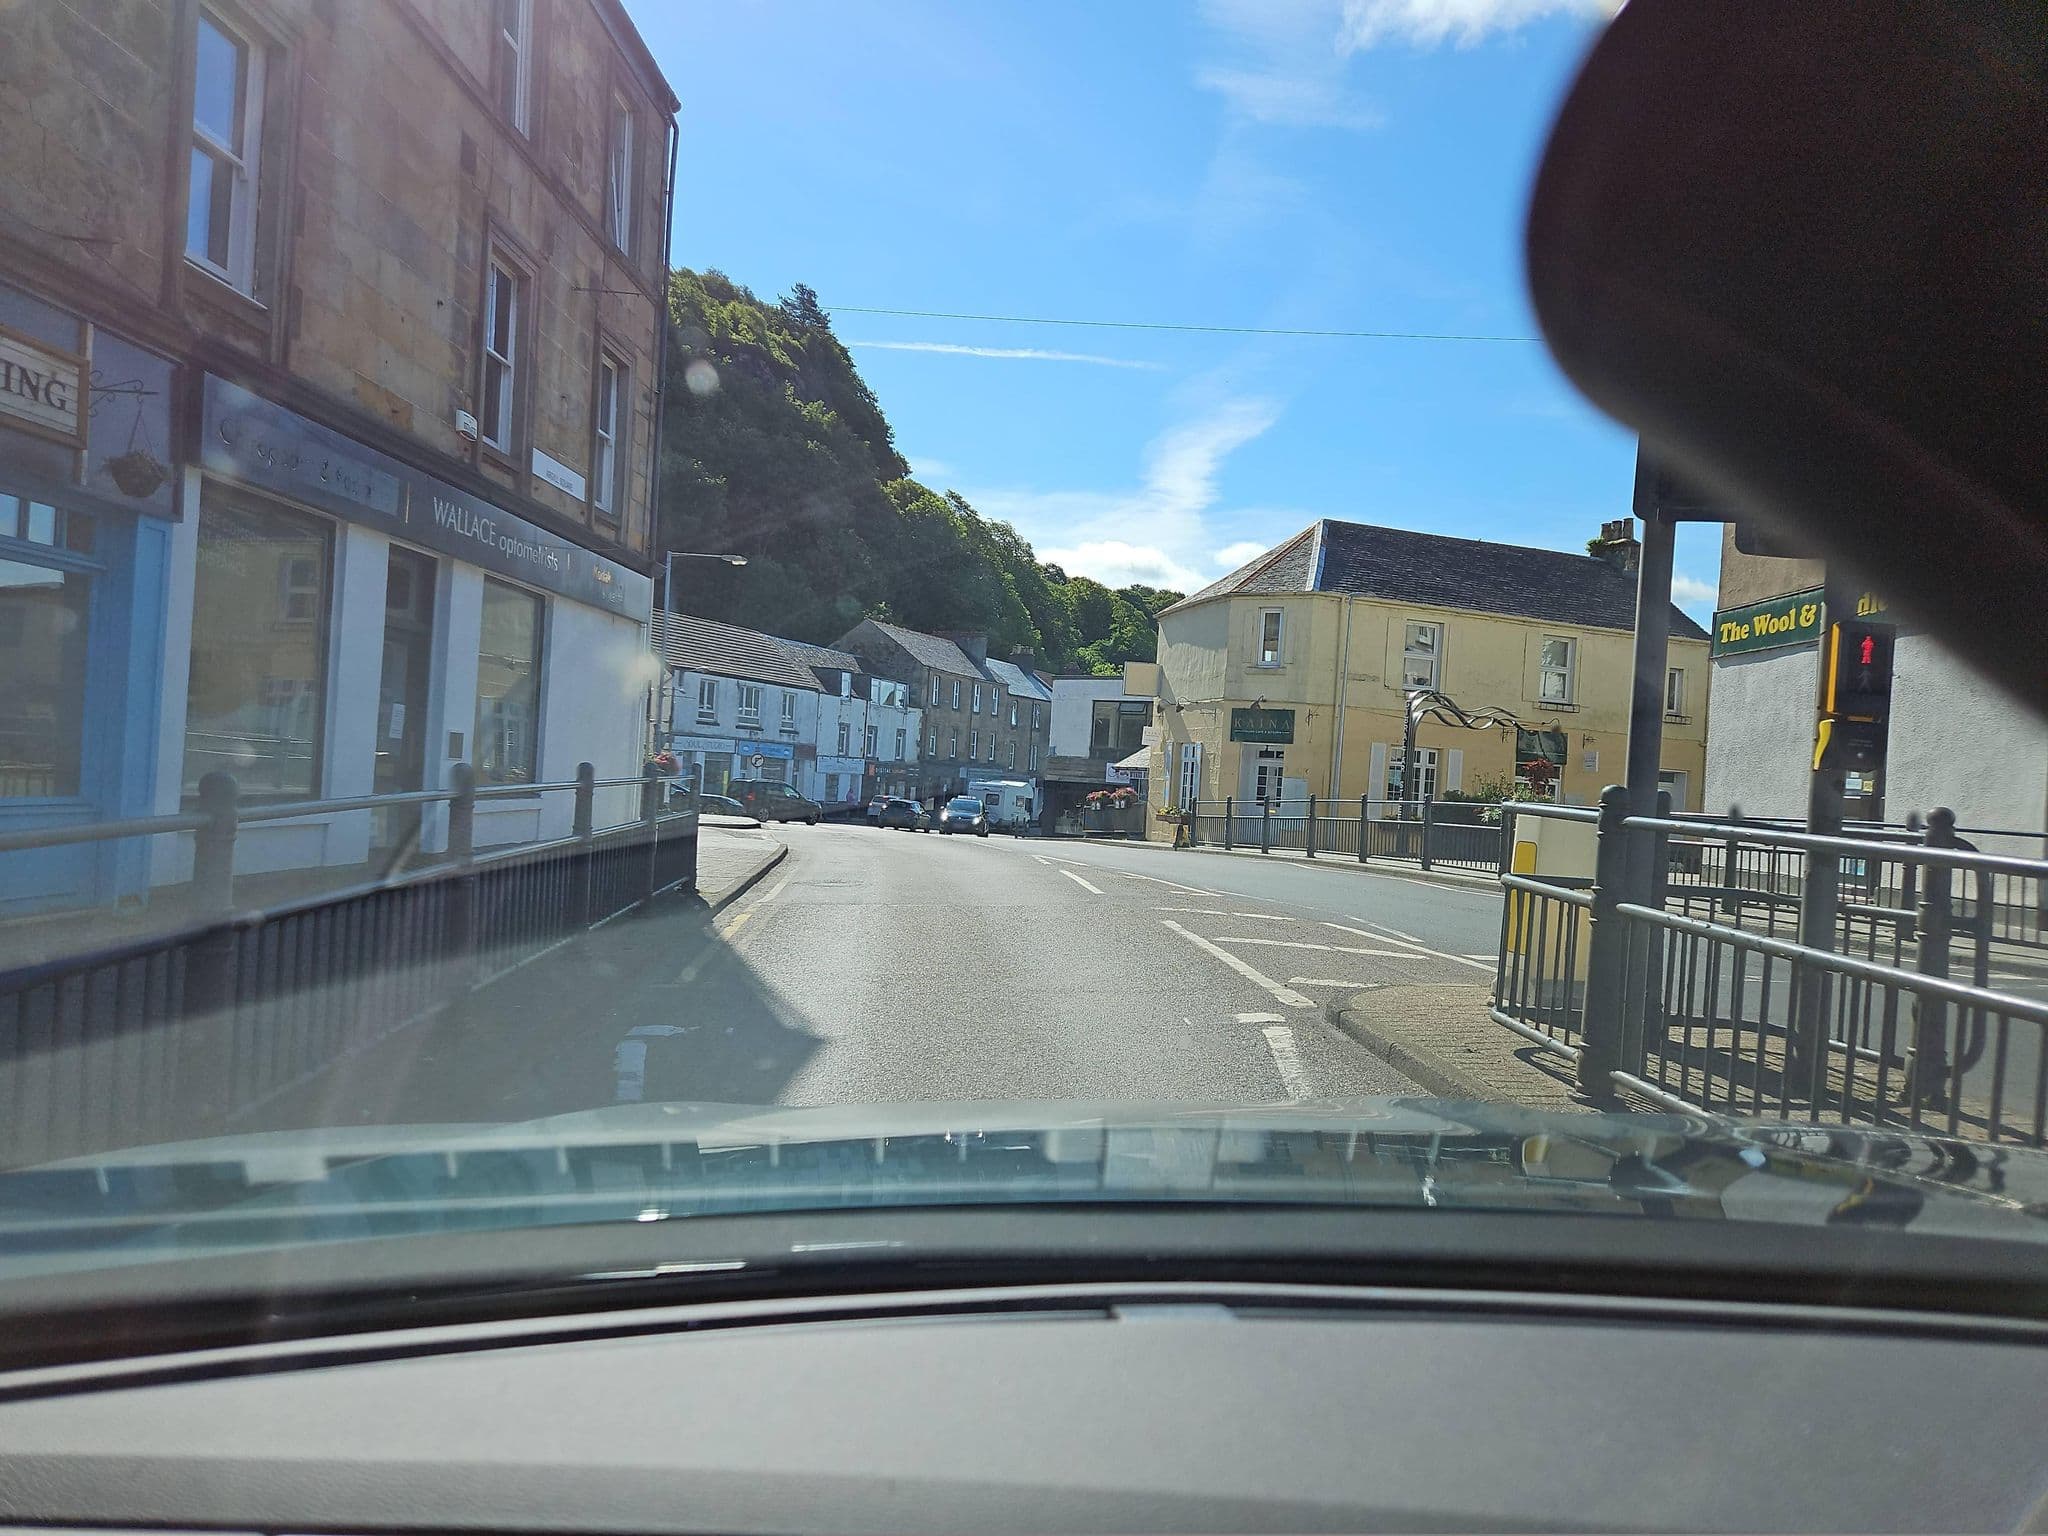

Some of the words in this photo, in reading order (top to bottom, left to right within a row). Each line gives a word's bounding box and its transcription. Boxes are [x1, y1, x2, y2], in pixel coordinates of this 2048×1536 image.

[433, 496, 497, 547] WALLACE
[499, 535, 559, 572] optometrists
[1720, 621, 1750, 643] The
[1754, 608, 1796, 637] Wool
[1800, 604, 1817, 628] &
